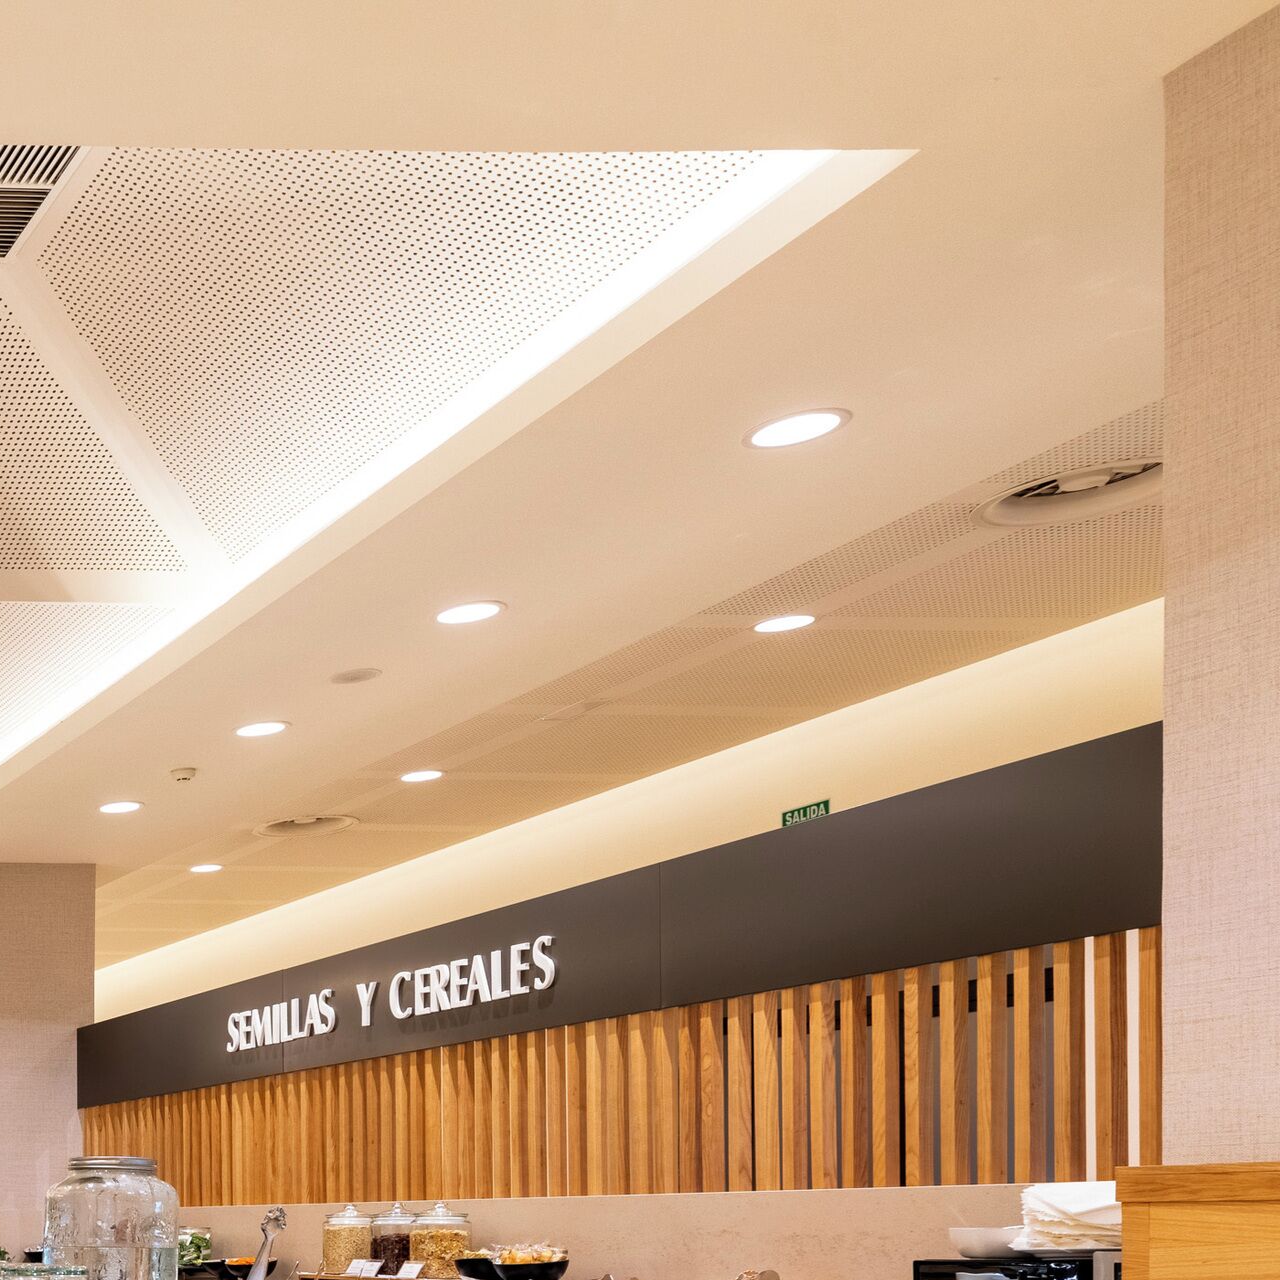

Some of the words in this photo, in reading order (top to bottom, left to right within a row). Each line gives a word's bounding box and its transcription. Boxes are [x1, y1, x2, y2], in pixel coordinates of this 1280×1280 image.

[785, 803, 826, 825] SALIDA
[226, 988, 336, 1053] SEMILLAS
[355, 981, 378, 1027] Y
[389, 935, 557, 1020] CEREALES
